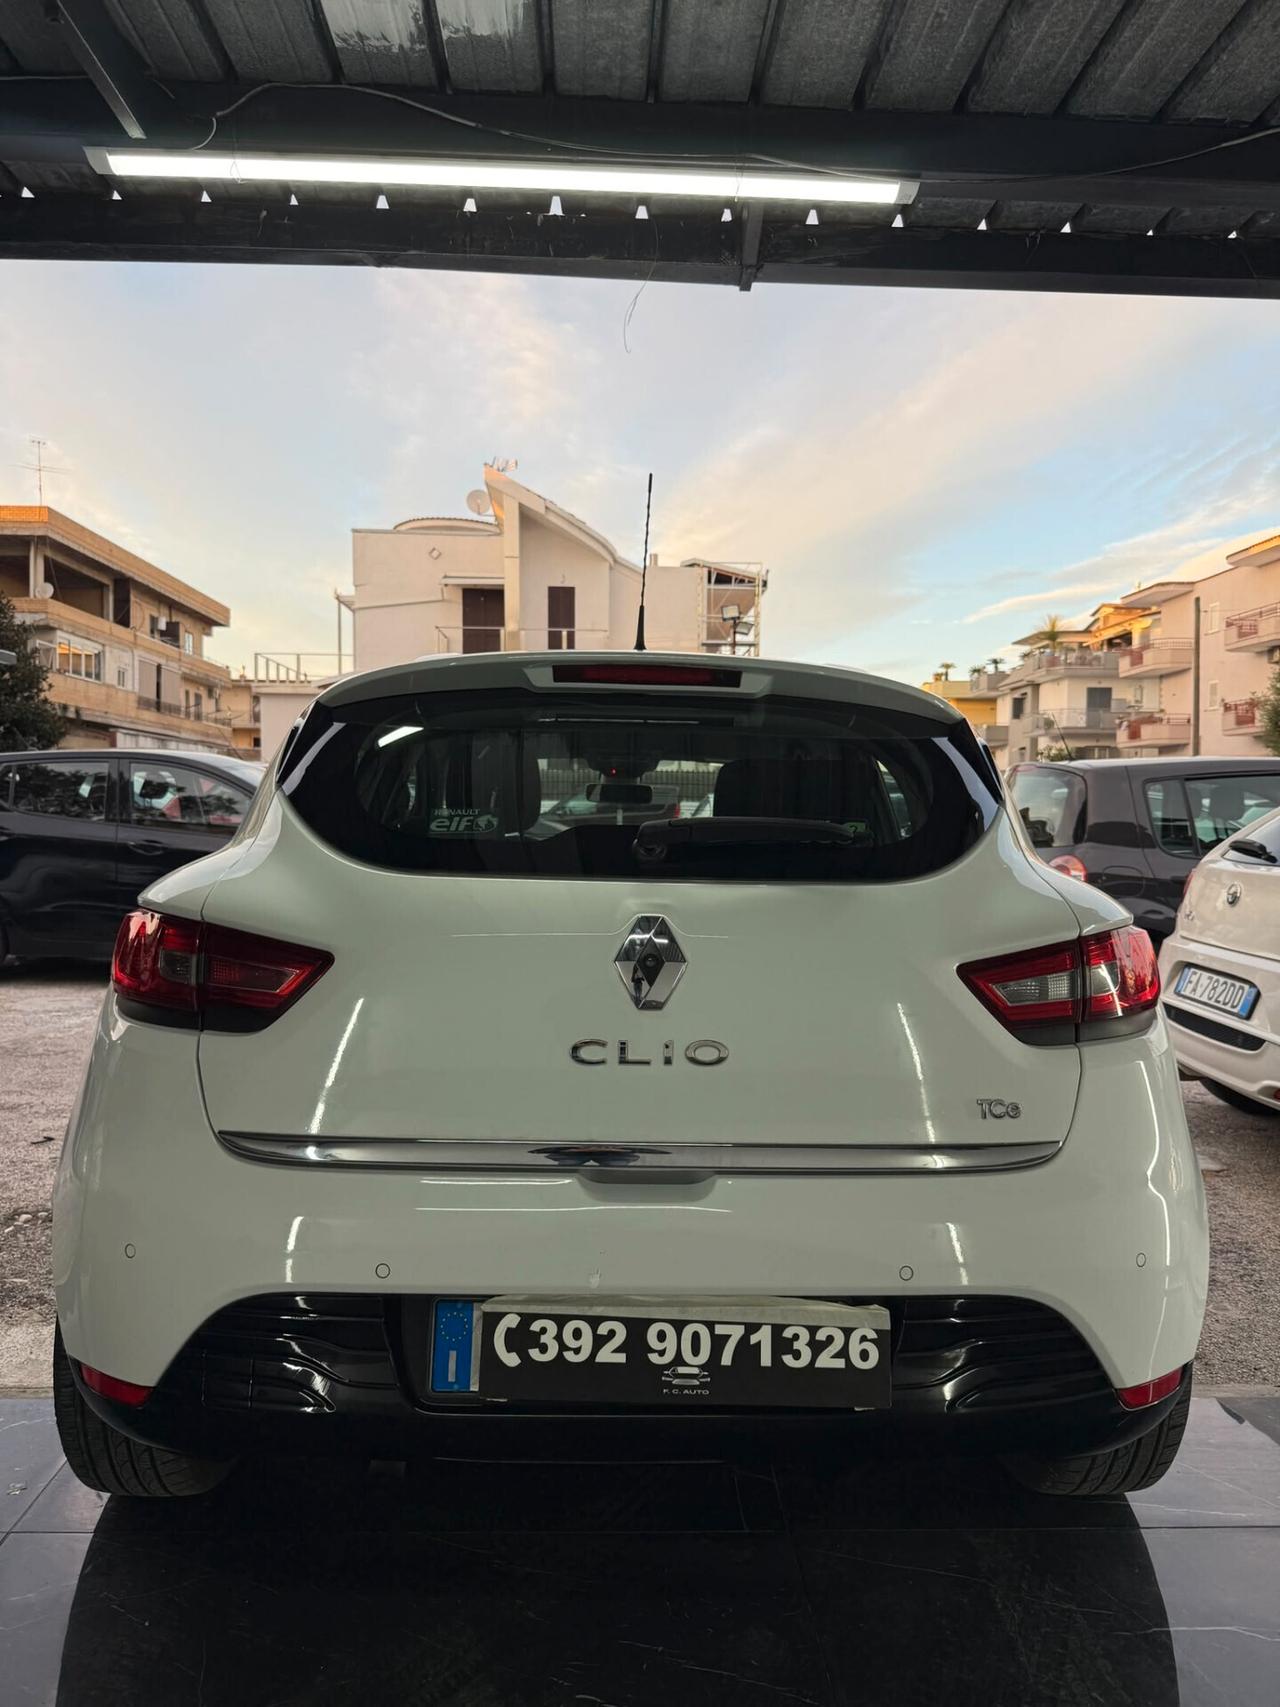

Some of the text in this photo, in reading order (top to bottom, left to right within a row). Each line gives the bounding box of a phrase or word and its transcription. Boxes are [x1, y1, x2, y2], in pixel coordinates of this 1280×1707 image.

[433, 808, 480, 816] RNAULT
[528, 1319, 879, 1369] 392 9071326
